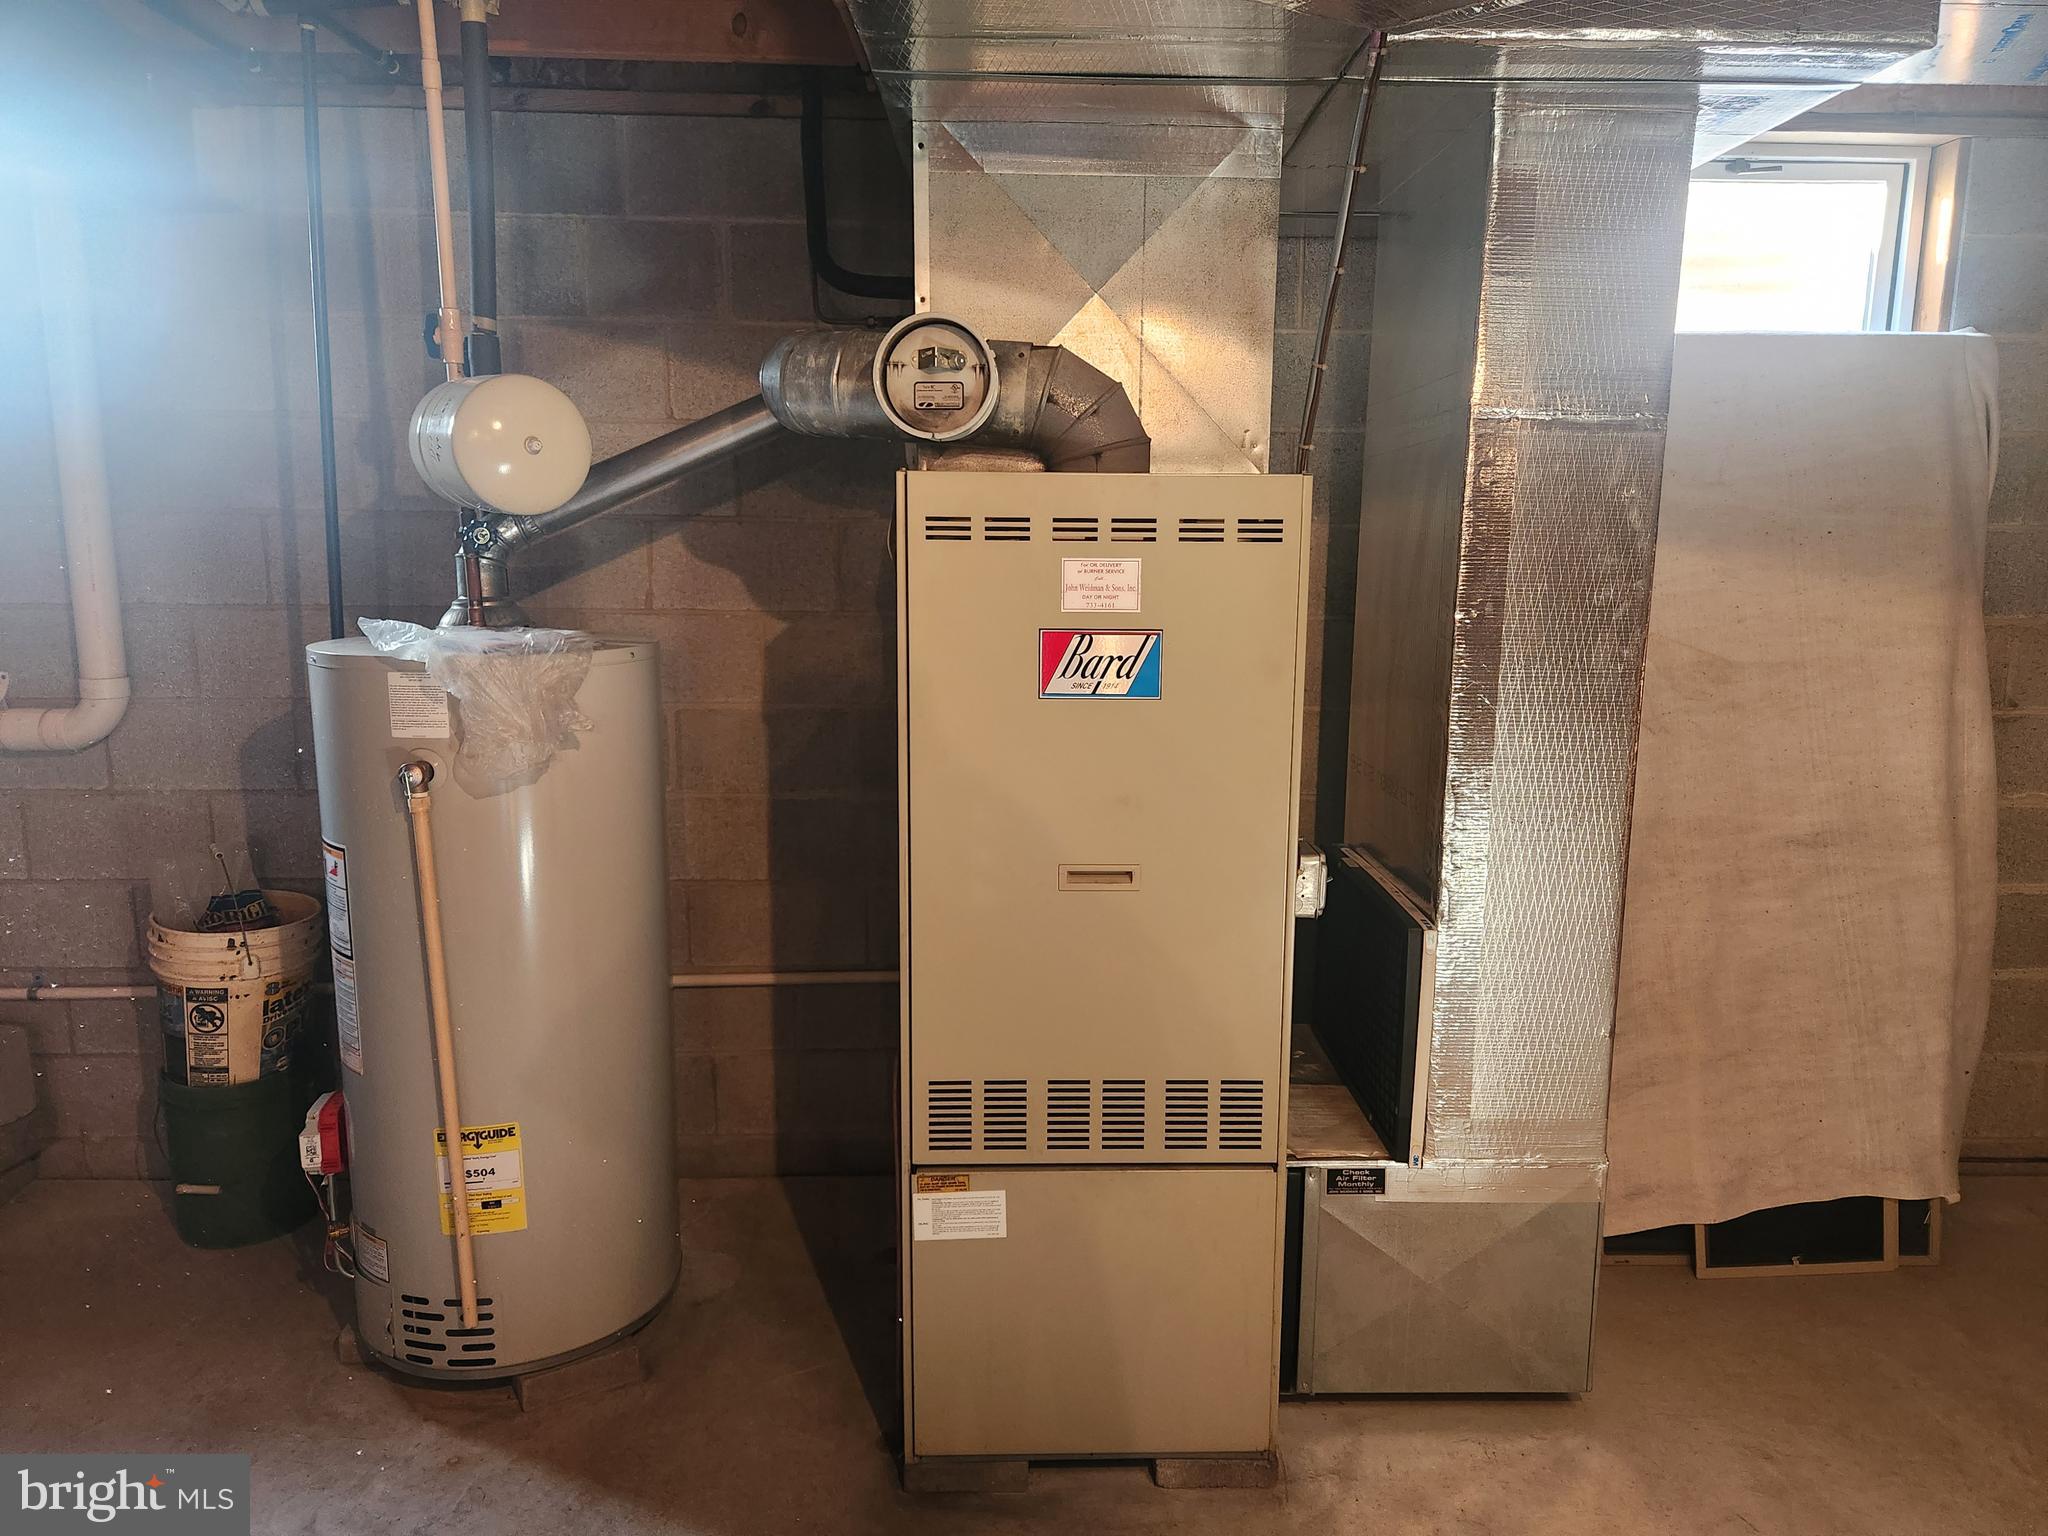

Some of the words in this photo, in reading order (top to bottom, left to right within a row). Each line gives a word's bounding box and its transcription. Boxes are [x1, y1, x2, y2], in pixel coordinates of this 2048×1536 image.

[1065, 584, 1078, 592] John
[1105, 584, 1111, 592] &
[1057, 634, 1152, 680] Bard
[1070, 682, 1094, 690] SINCE
[1102, 682, 1119, 690] 1914
[465, 1167, 496, 1179] $504
